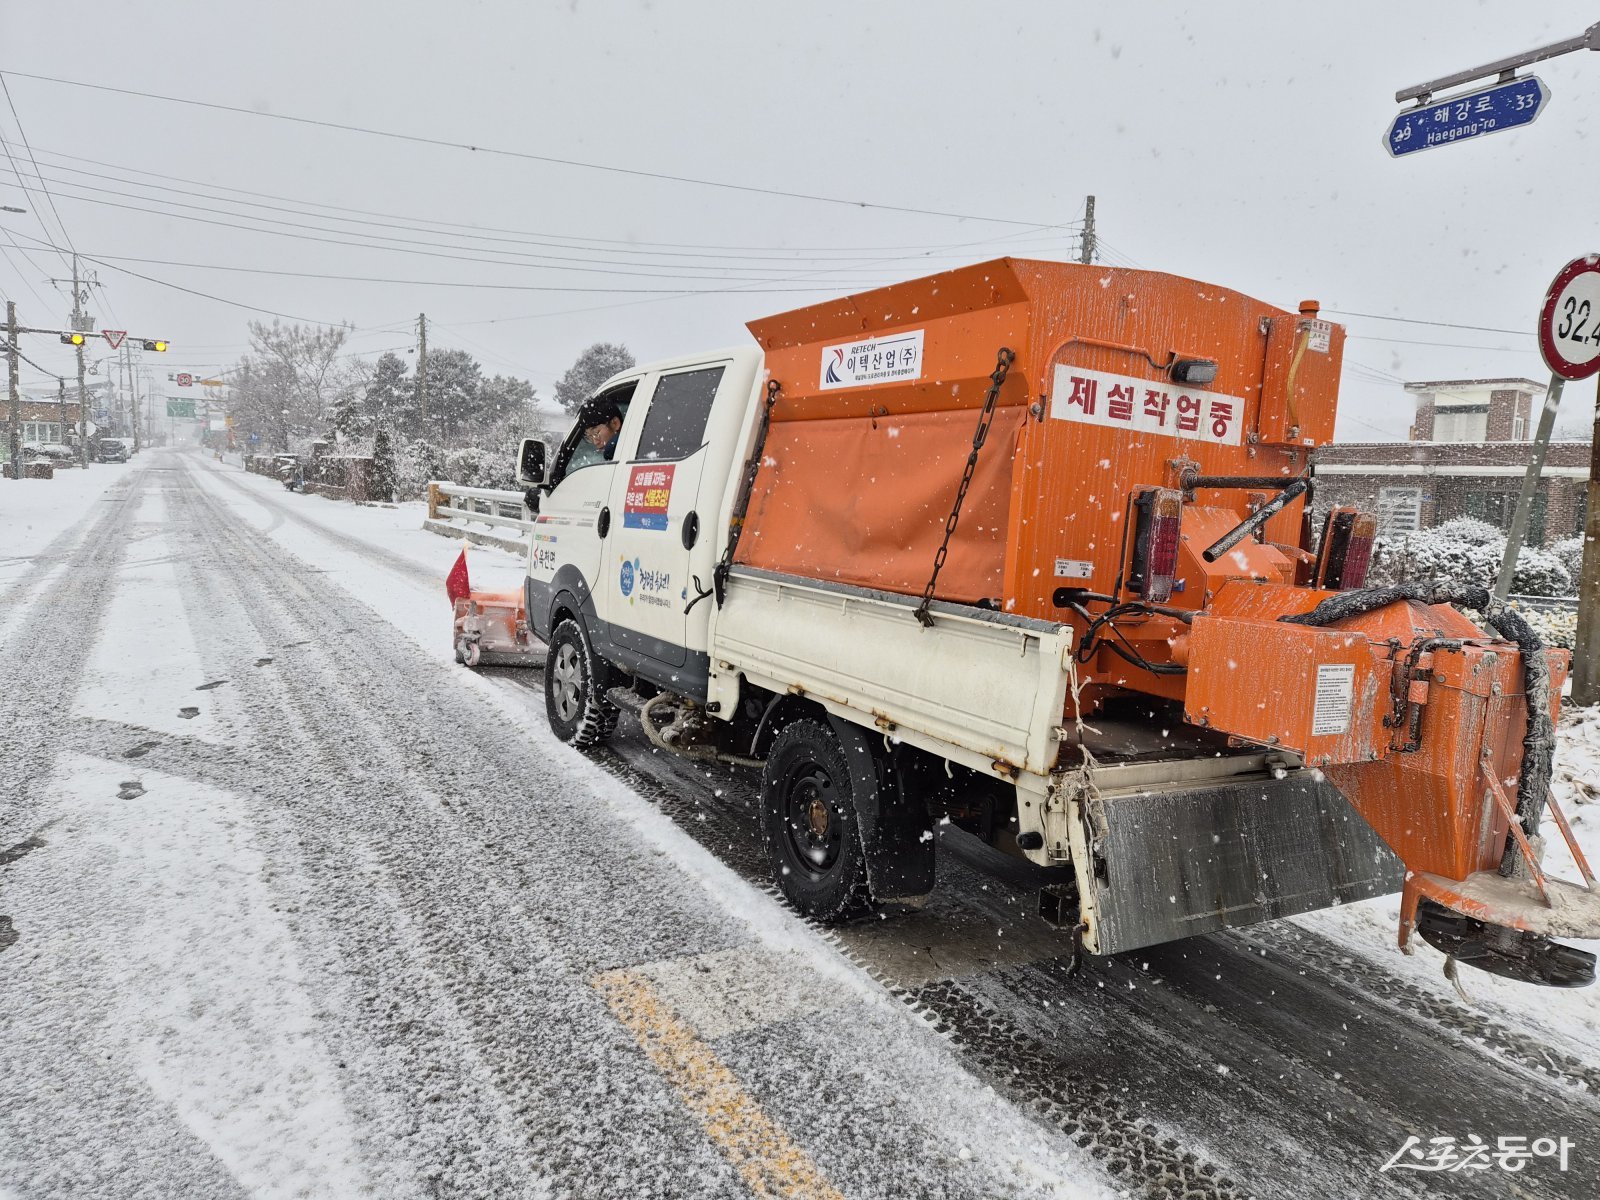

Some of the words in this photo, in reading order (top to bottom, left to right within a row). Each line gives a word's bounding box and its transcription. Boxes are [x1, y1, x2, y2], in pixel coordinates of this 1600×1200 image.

[1394, 126, 1412, 143] 29
[1434, 96, 1494, 123] 해강로
[1515, 93, 1535, 111] 33
[1427, 118, 1496, 144] Haegang-ro
[847, 345, 917, 374] 이텍산업(주)
[851, 343, 877, 355] RETECH
[1067, 376, 1233, 438] 제설작업중
[539, 549, 556, 571] 옥천면
